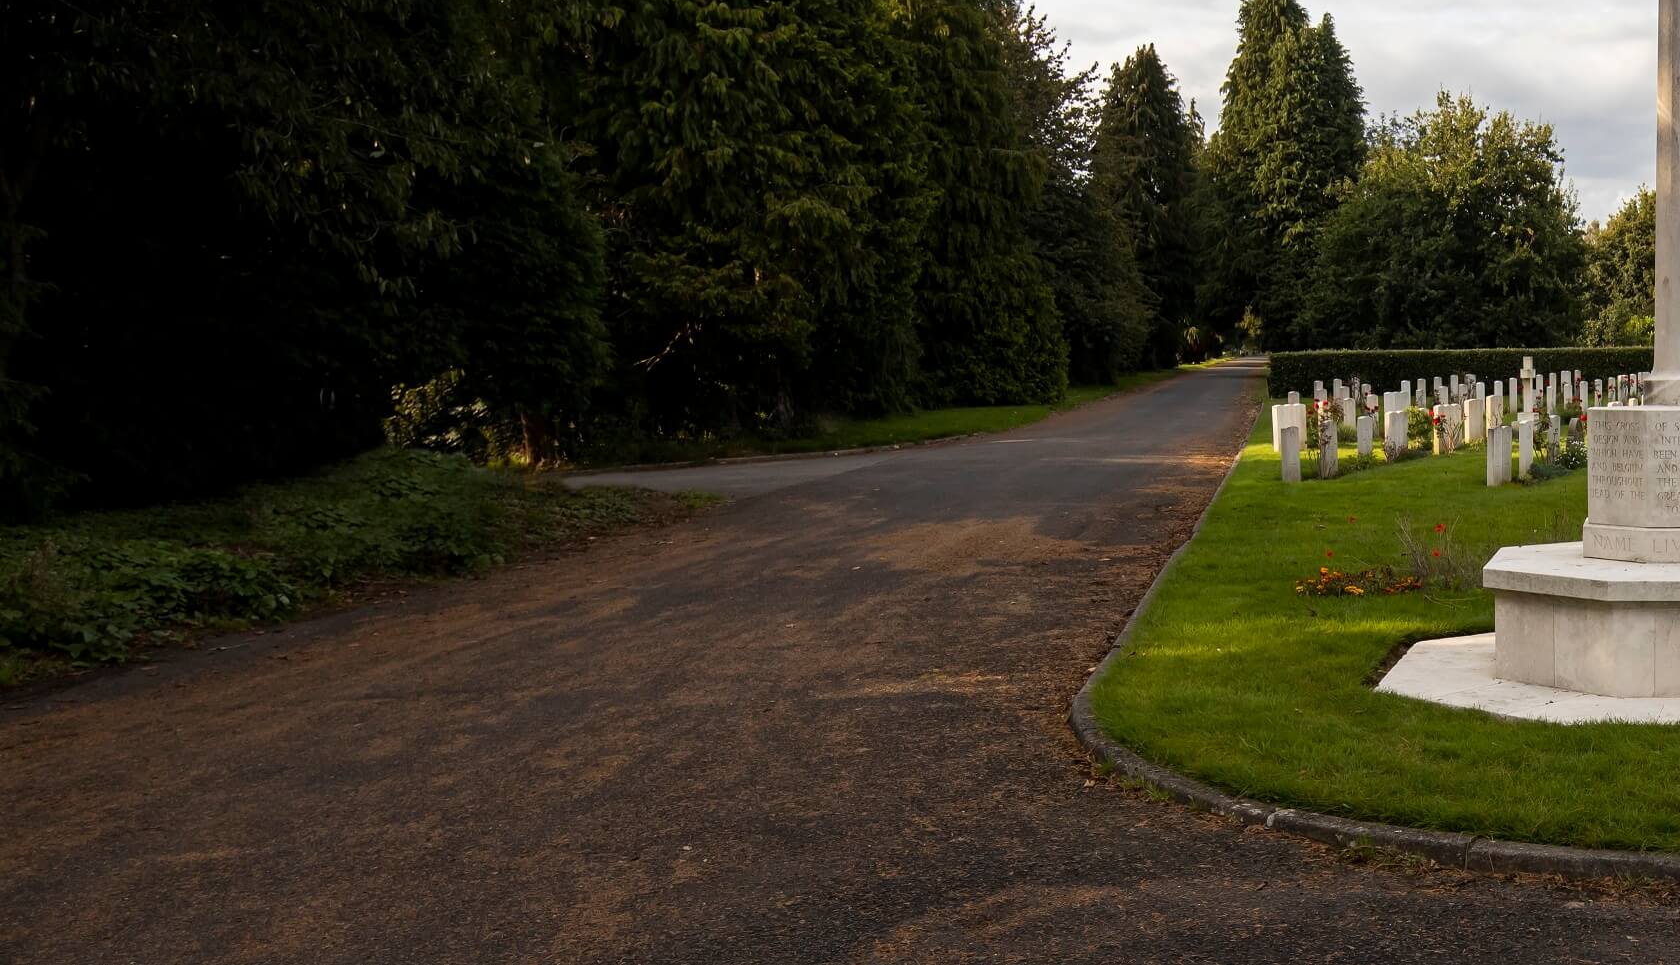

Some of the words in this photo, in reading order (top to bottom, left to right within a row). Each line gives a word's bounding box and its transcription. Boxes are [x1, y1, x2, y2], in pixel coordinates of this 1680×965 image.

[1655, 421, 1667, 431] OF
[1593, 434, 1619, 445] DESIGN
[1623, 434, 1641, 445] AND
[1591, 447, 1617, 458] WHICH
[1622, 448, 1644, 459] HAVE
[1653, 450, 1678, 460] BEEN
[1656, 463, 1678, 474] AND
[1656, 477, 1678, 487] THE
[1615, 491, 1625, 500] OF
[1630, 491, 1646, 501] THE
[1664, 505, 1679, 515] TO
[1593, 533, 1635, 553] NAME
